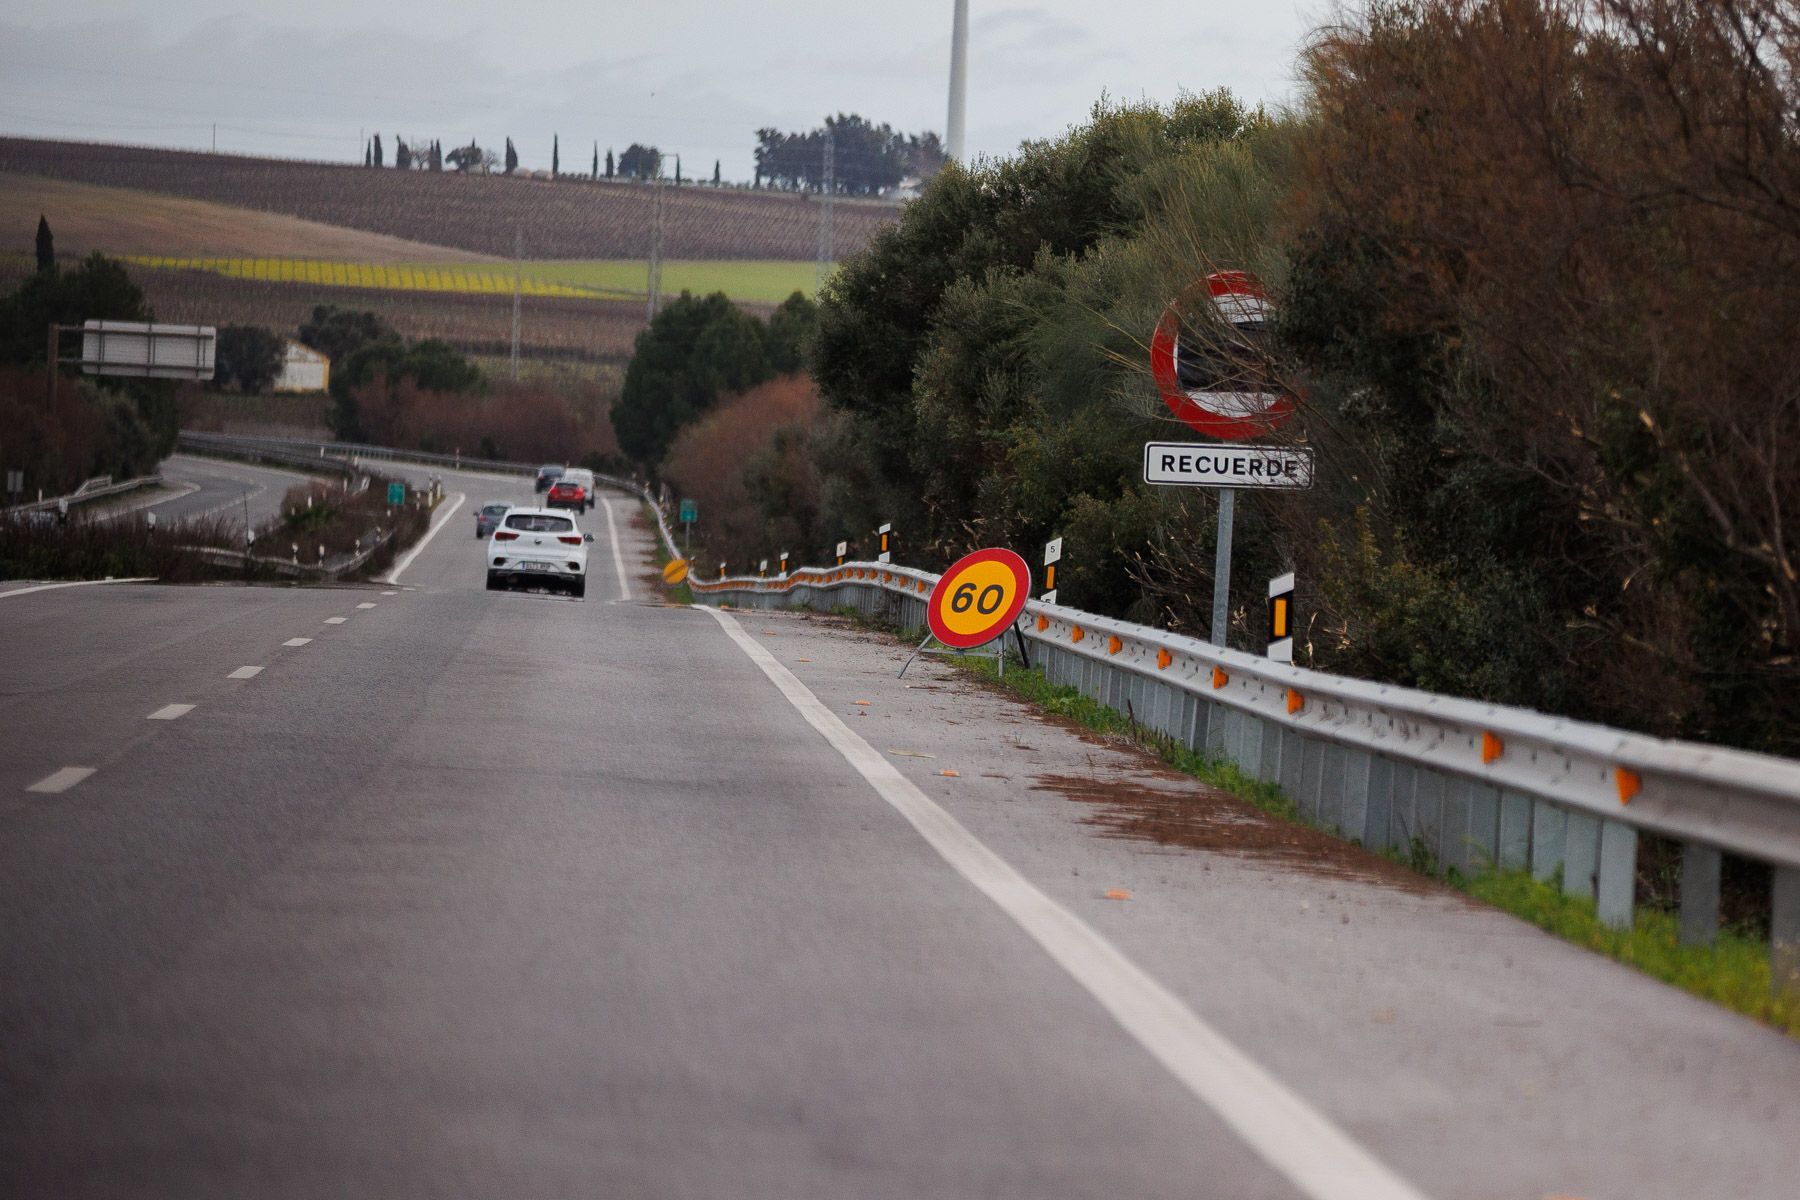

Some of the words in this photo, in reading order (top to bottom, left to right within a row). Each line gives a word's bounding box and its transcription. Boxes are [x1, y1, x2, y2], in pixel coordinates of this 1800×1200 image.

[1161, 454, 1298, 478] RECUERDE
[1050, 545, 1056, 553] 5
[951, 582, 1004, 615] 60
